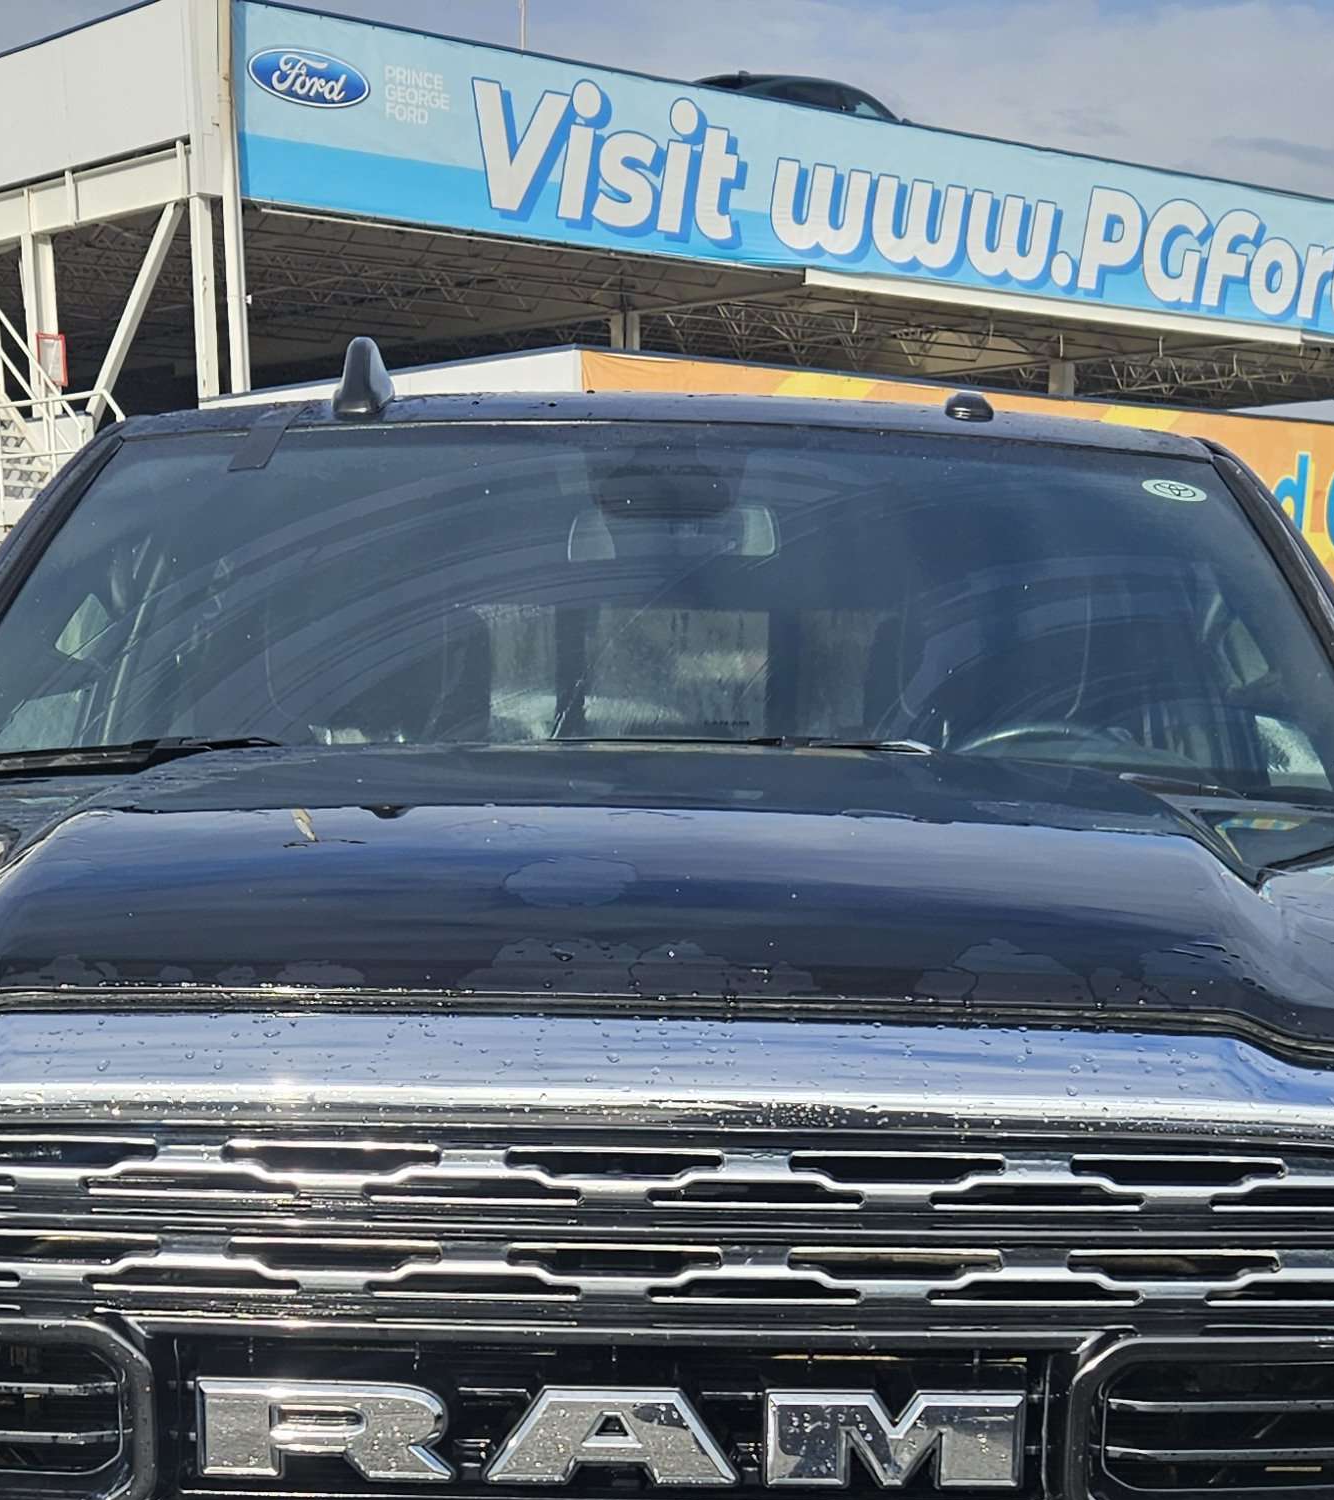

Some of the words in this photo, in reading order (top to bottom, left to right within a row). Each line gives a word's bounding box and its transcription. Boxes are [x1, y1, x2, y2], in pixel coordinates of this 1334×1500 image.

[267, 50, 351, 105] Ford
[385, 65, 444, 89] PRINCE
[385, 84, 451, 110] GEORGE
[385, 104, 429, 124] FORD
[470, 76, 741, 241] Visit
[195, 1376, 1027, 1490] RAM
